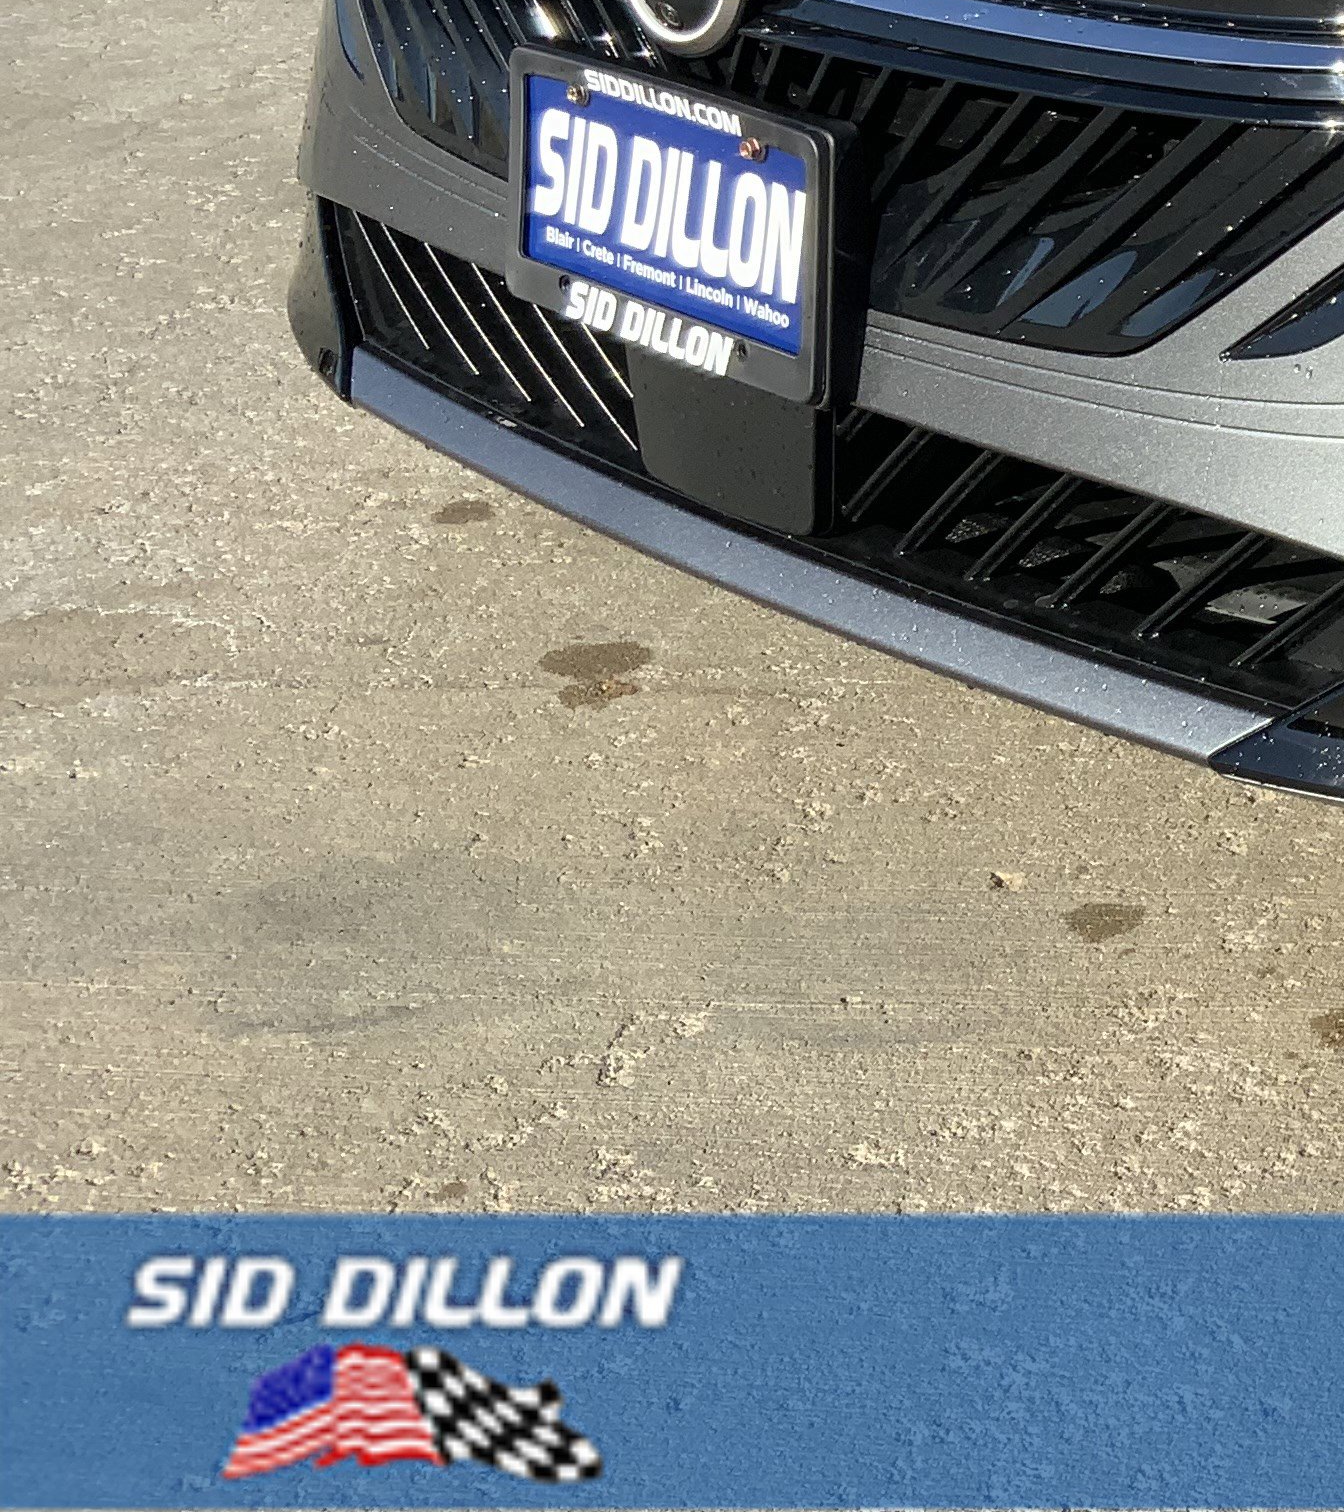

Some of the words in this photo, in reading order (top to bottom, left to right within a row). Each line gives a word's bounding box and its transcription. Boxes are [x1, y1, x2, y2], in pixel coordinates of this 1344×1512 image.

[583, 68, 743, 138] SIDDILLON.COM
[533, 107, 618, 236] SID
[621, 135, 807, 307] DILLON
[545, 226, 575, 252] Blair
[582, 238, 615, 266] Crete
[622, 254, 677, 289] Fremont
[685, 276, 734, 309] Lincoln
[743, 295, 790, 330] Wahoo
[564, 280, 618, 333] SID
[618, 299, 735, 378] DILLON
